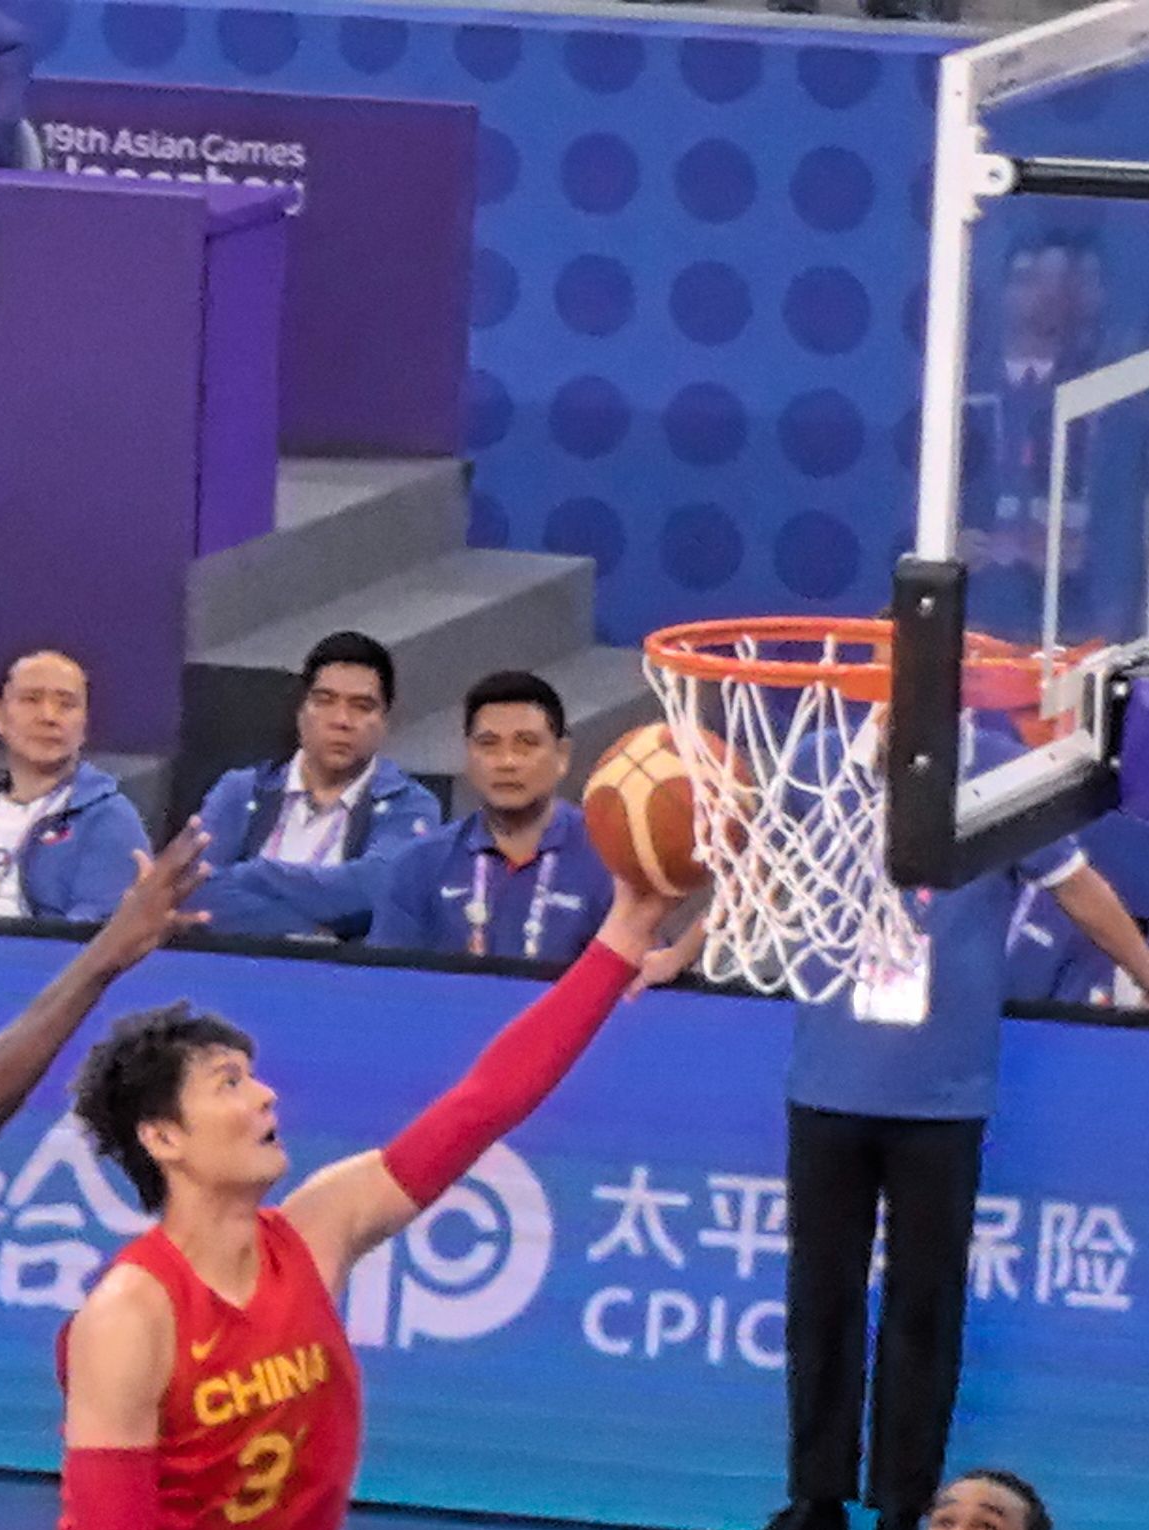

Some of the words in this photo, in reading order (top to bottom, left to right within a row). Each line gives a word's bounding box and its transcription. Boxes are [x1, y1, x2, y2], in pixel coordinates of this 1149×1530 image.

[42, 122, 108, 155] 19th
[112, 129, 197, 161] Asian
[200, 132, 307, 169] Games
[586, 1164, 1138, 1312] 太平保险
[581, 1286, 788, 1370] CPIC
[193, 1344, 327, 1427] CHINA
[223, 1432, 295, 1524] 3
